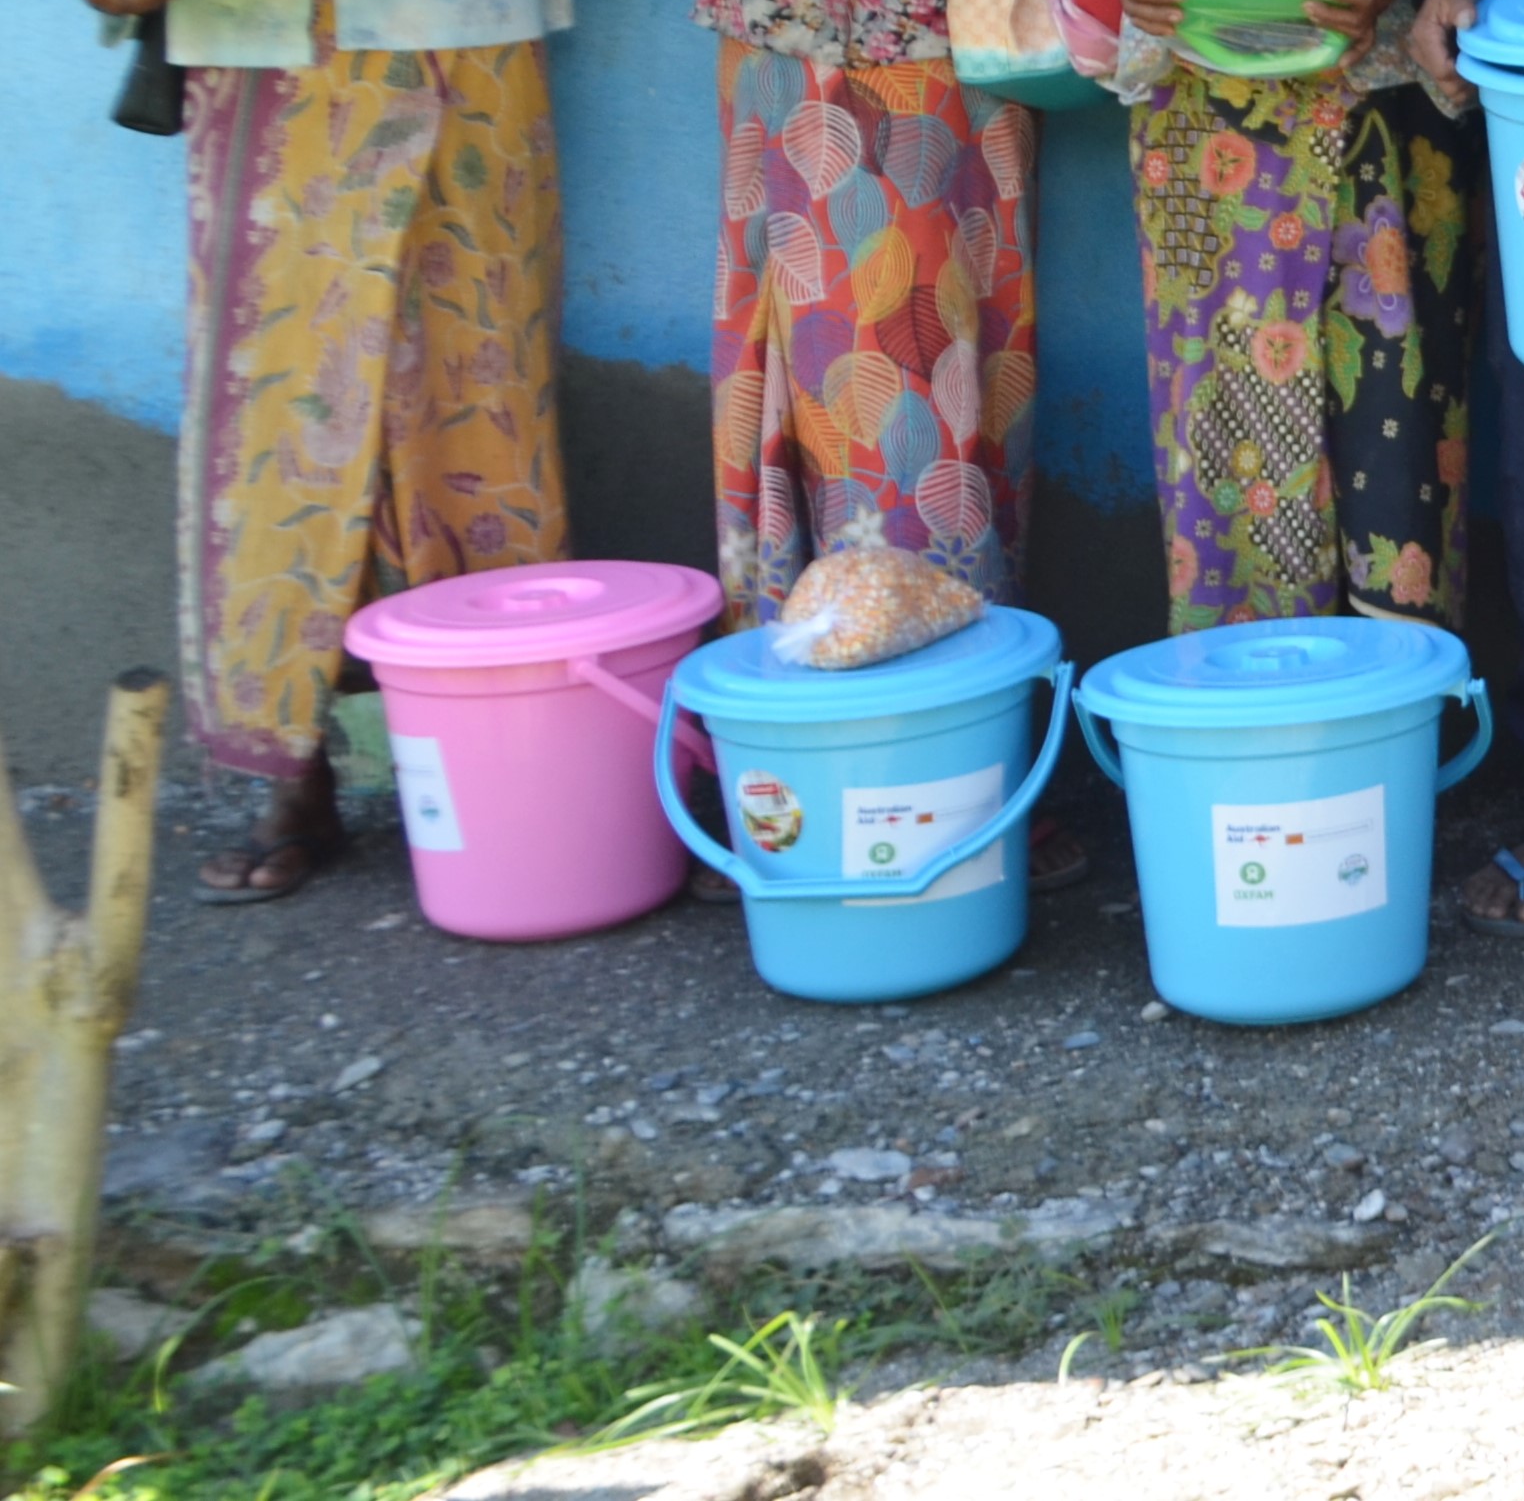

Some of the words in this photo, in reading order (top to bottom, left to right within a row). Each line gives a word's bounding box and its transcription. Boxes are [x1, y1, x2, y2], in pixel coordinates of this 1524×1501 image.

[1226, 824, 1281, 833] Australian
[1226, 834, 1245, 843] Aid
[1233, 890, 1274, 900] OXFAM
